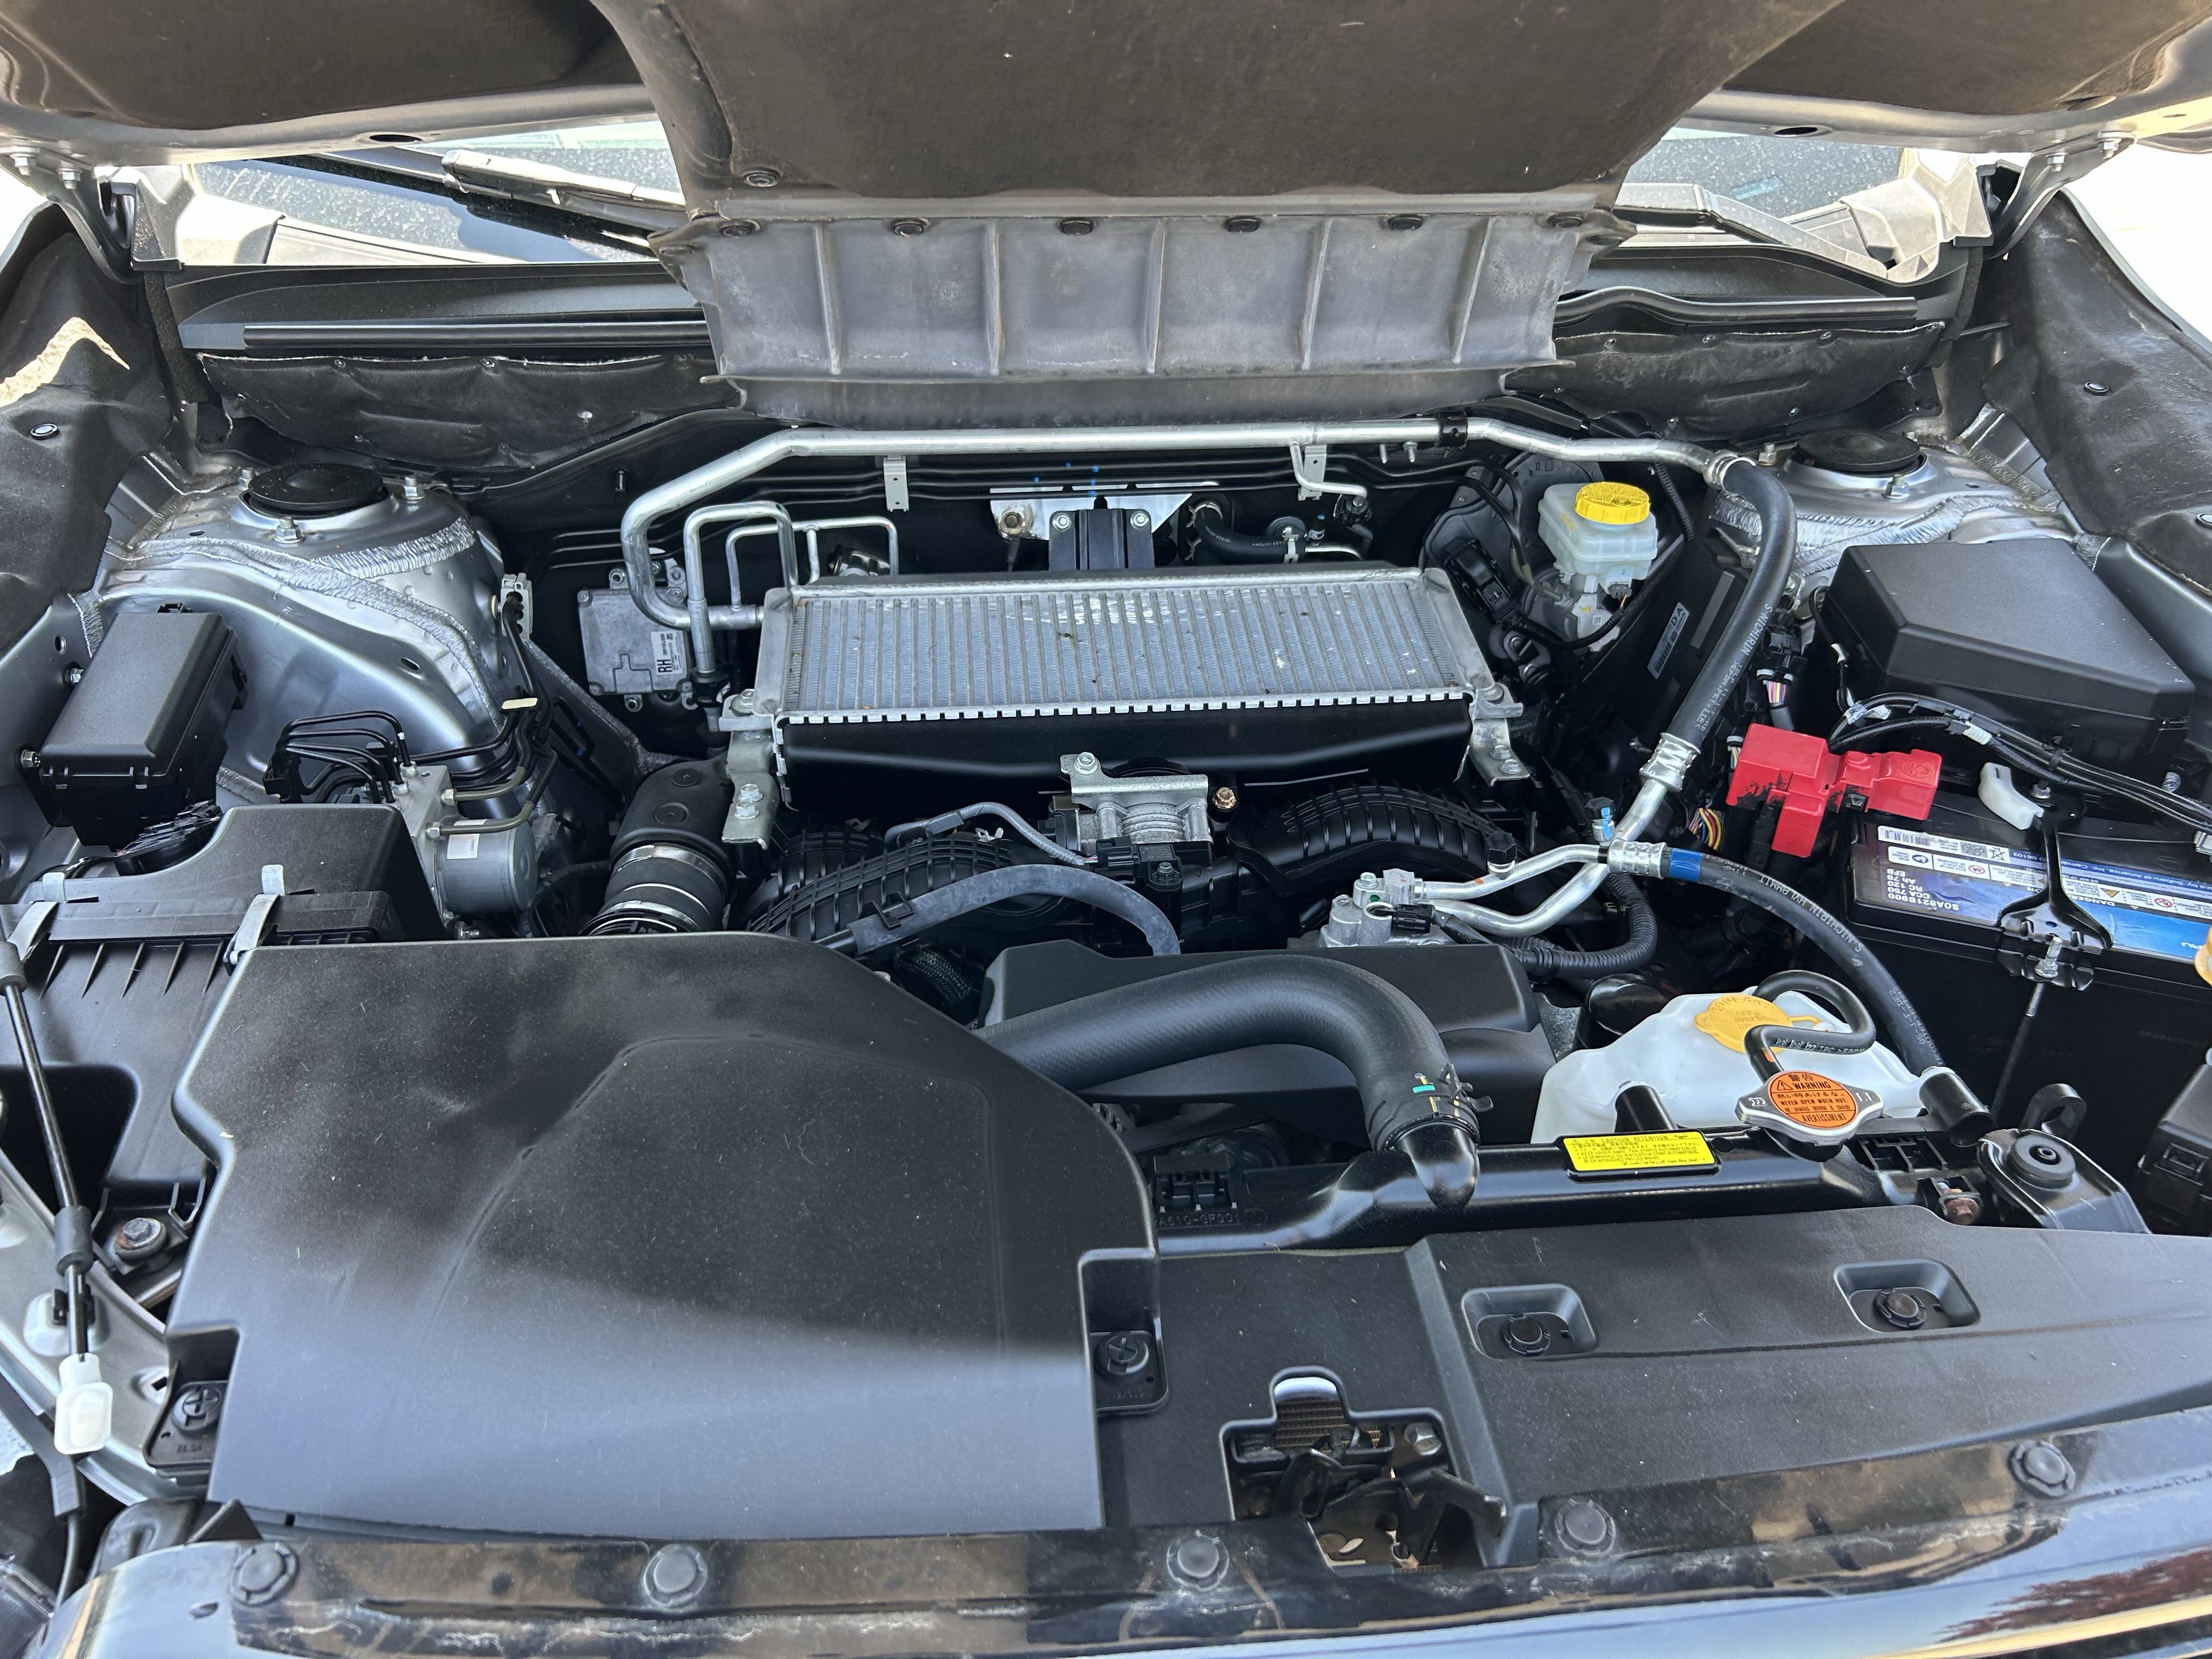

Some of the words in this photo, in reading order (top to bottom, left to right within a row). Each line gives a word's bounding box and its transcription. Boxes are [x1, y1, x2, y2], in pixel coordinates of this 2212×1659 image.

[656, 659, 673, 673] RH
[1886, 868, 1906, 877] EFB
[1887, 881, 1906, 889] 120
[2153, 877, 2183, 886] Subaru
[1887, 887, 1906, 895] 750
[1909, 890, 1930, 899] CCA
[1788, 1074, 1814, 1082] 警告
[1792, 1081, 1831, 1090] WARNING
